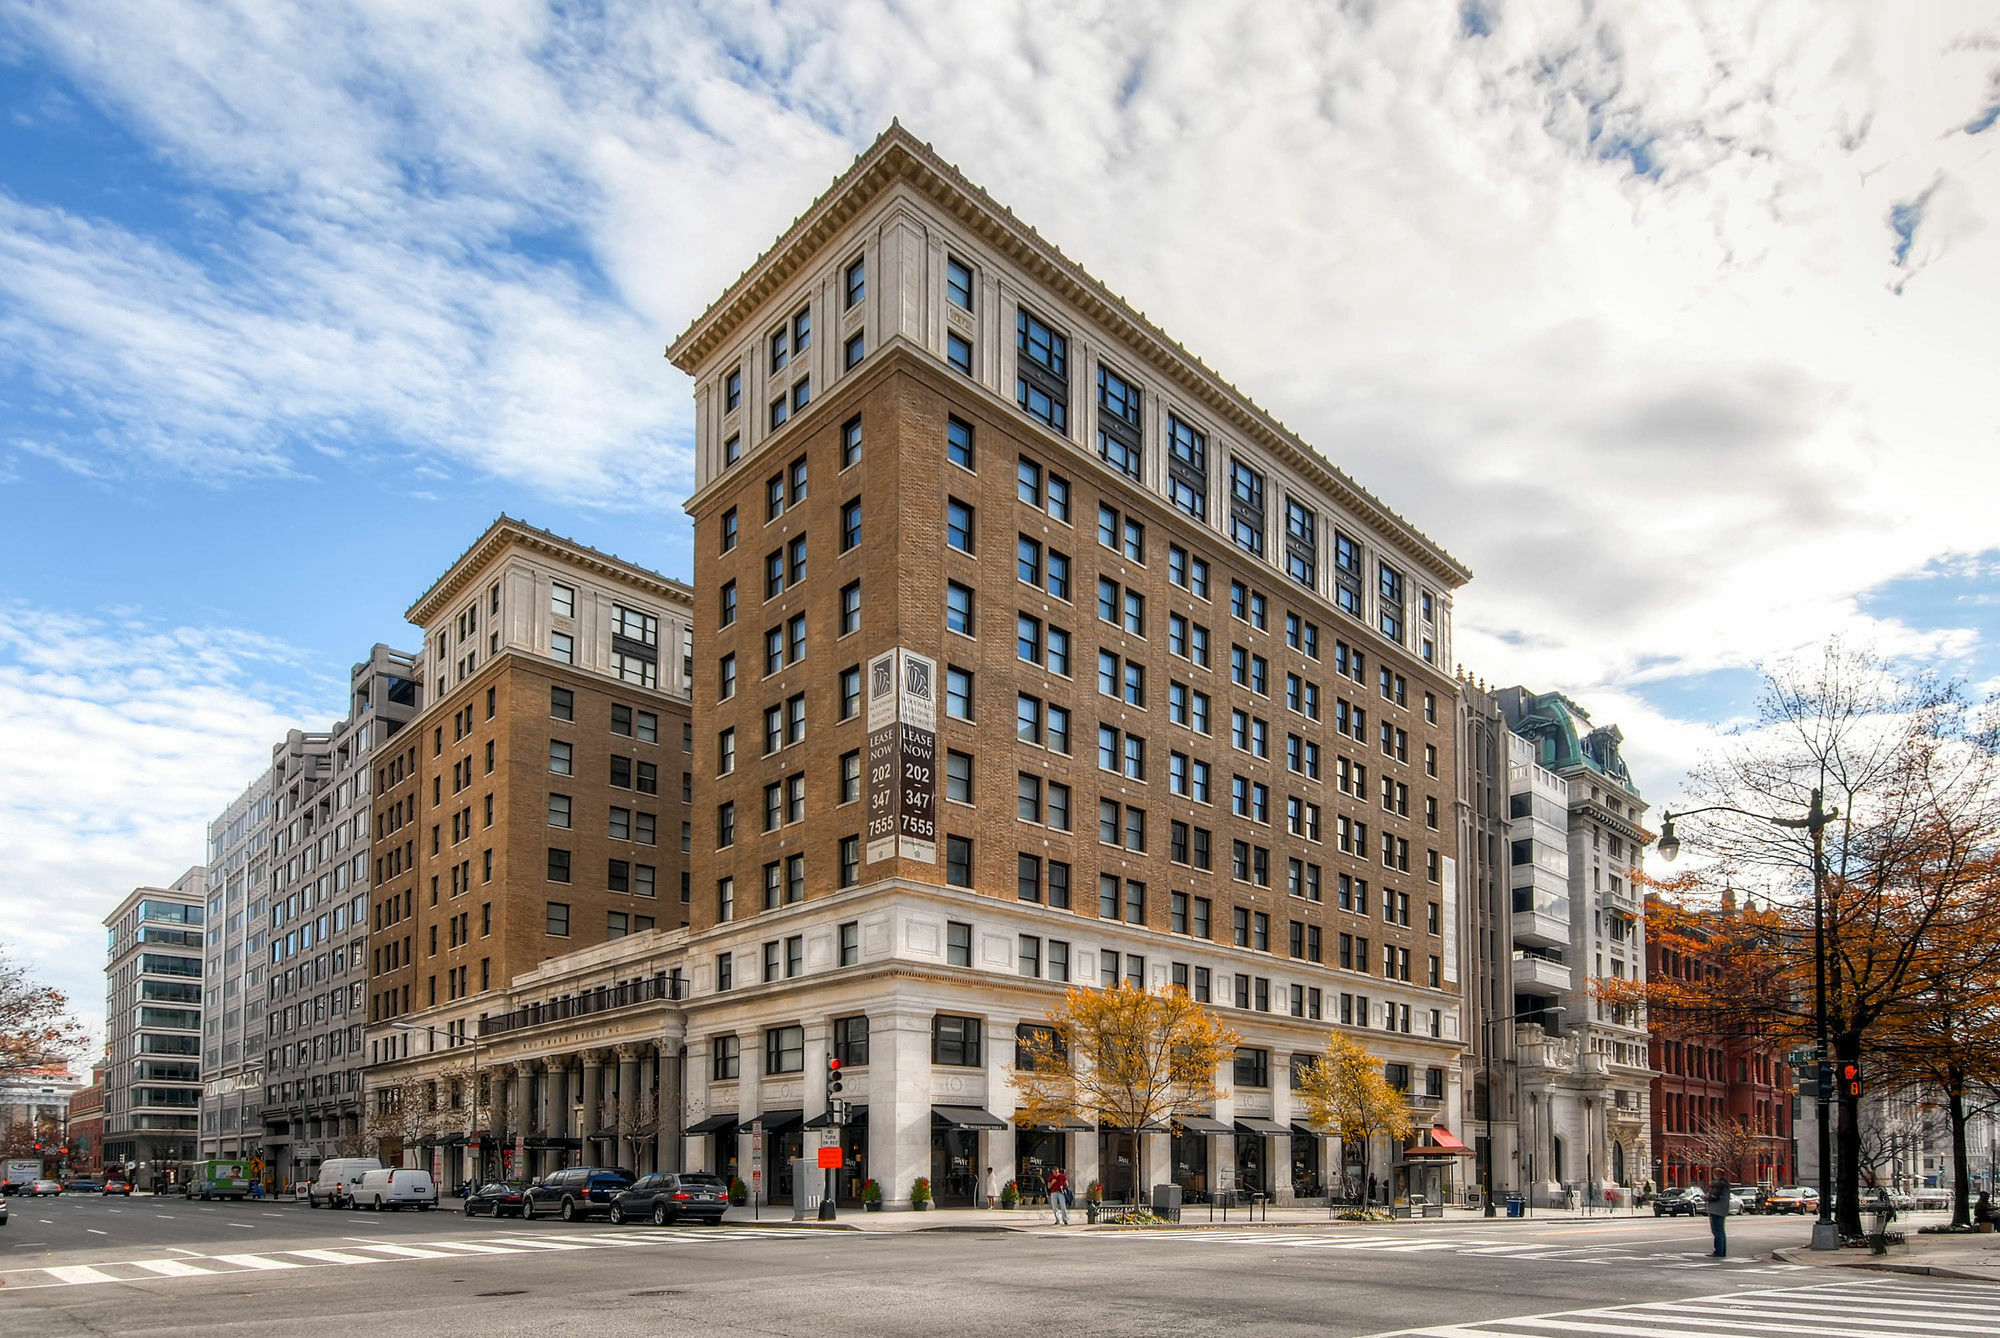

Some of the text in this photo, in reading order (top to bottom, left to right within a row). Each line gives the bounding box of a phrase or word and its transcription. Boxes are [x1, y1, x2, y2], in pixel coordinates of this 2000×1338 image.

[870, 729, 893, 747] LEASE
[902, 728, 932, 747] LEASE
[870, 743, 893, 760] NOW
[903, 743, 932, 760] NOW
[872, 763, 891, 783] 202
[905, 763, 930, 783] 202
[872, 789, 890, 809] 347
[905, 789, 929, 808] 347
[869, 815, 893, 836] 7555
[901, 815, 933, 836] 7555
[1788, 1053, 1796, 1061] H
